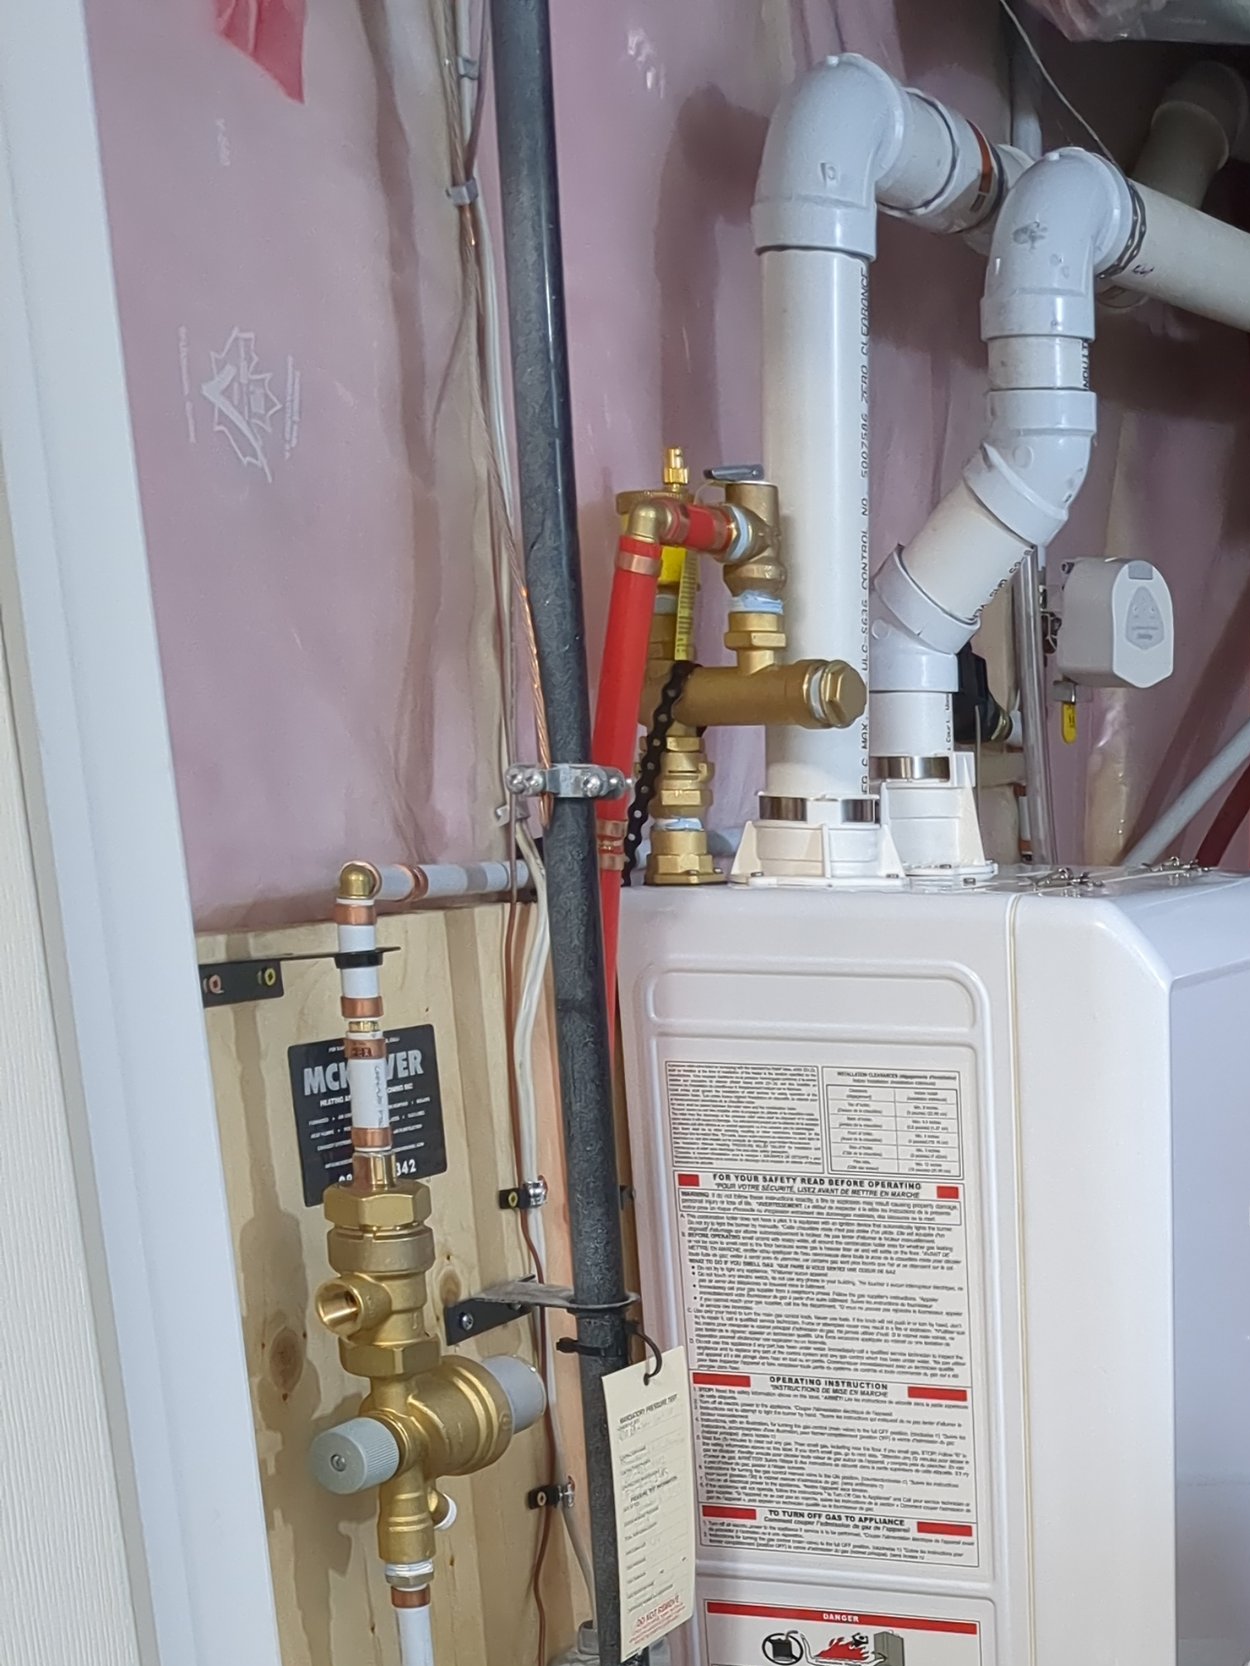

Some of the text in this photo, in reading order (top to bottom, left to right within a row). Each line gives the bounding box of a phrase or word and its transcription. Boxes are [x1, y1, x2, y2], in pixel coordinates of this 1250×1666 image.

[713, 1173, 922, 1191] FOR YOUR SAFETY READ BEFORE OPERATING
[769, 1376, 888, 1391] OPERATING INSTRUCTION
[782, 1511, 804, 1519] TURN
[858, 1517, 905, 1526] APPLIANCE
[822, 1612, 860, 1623] DANGER
